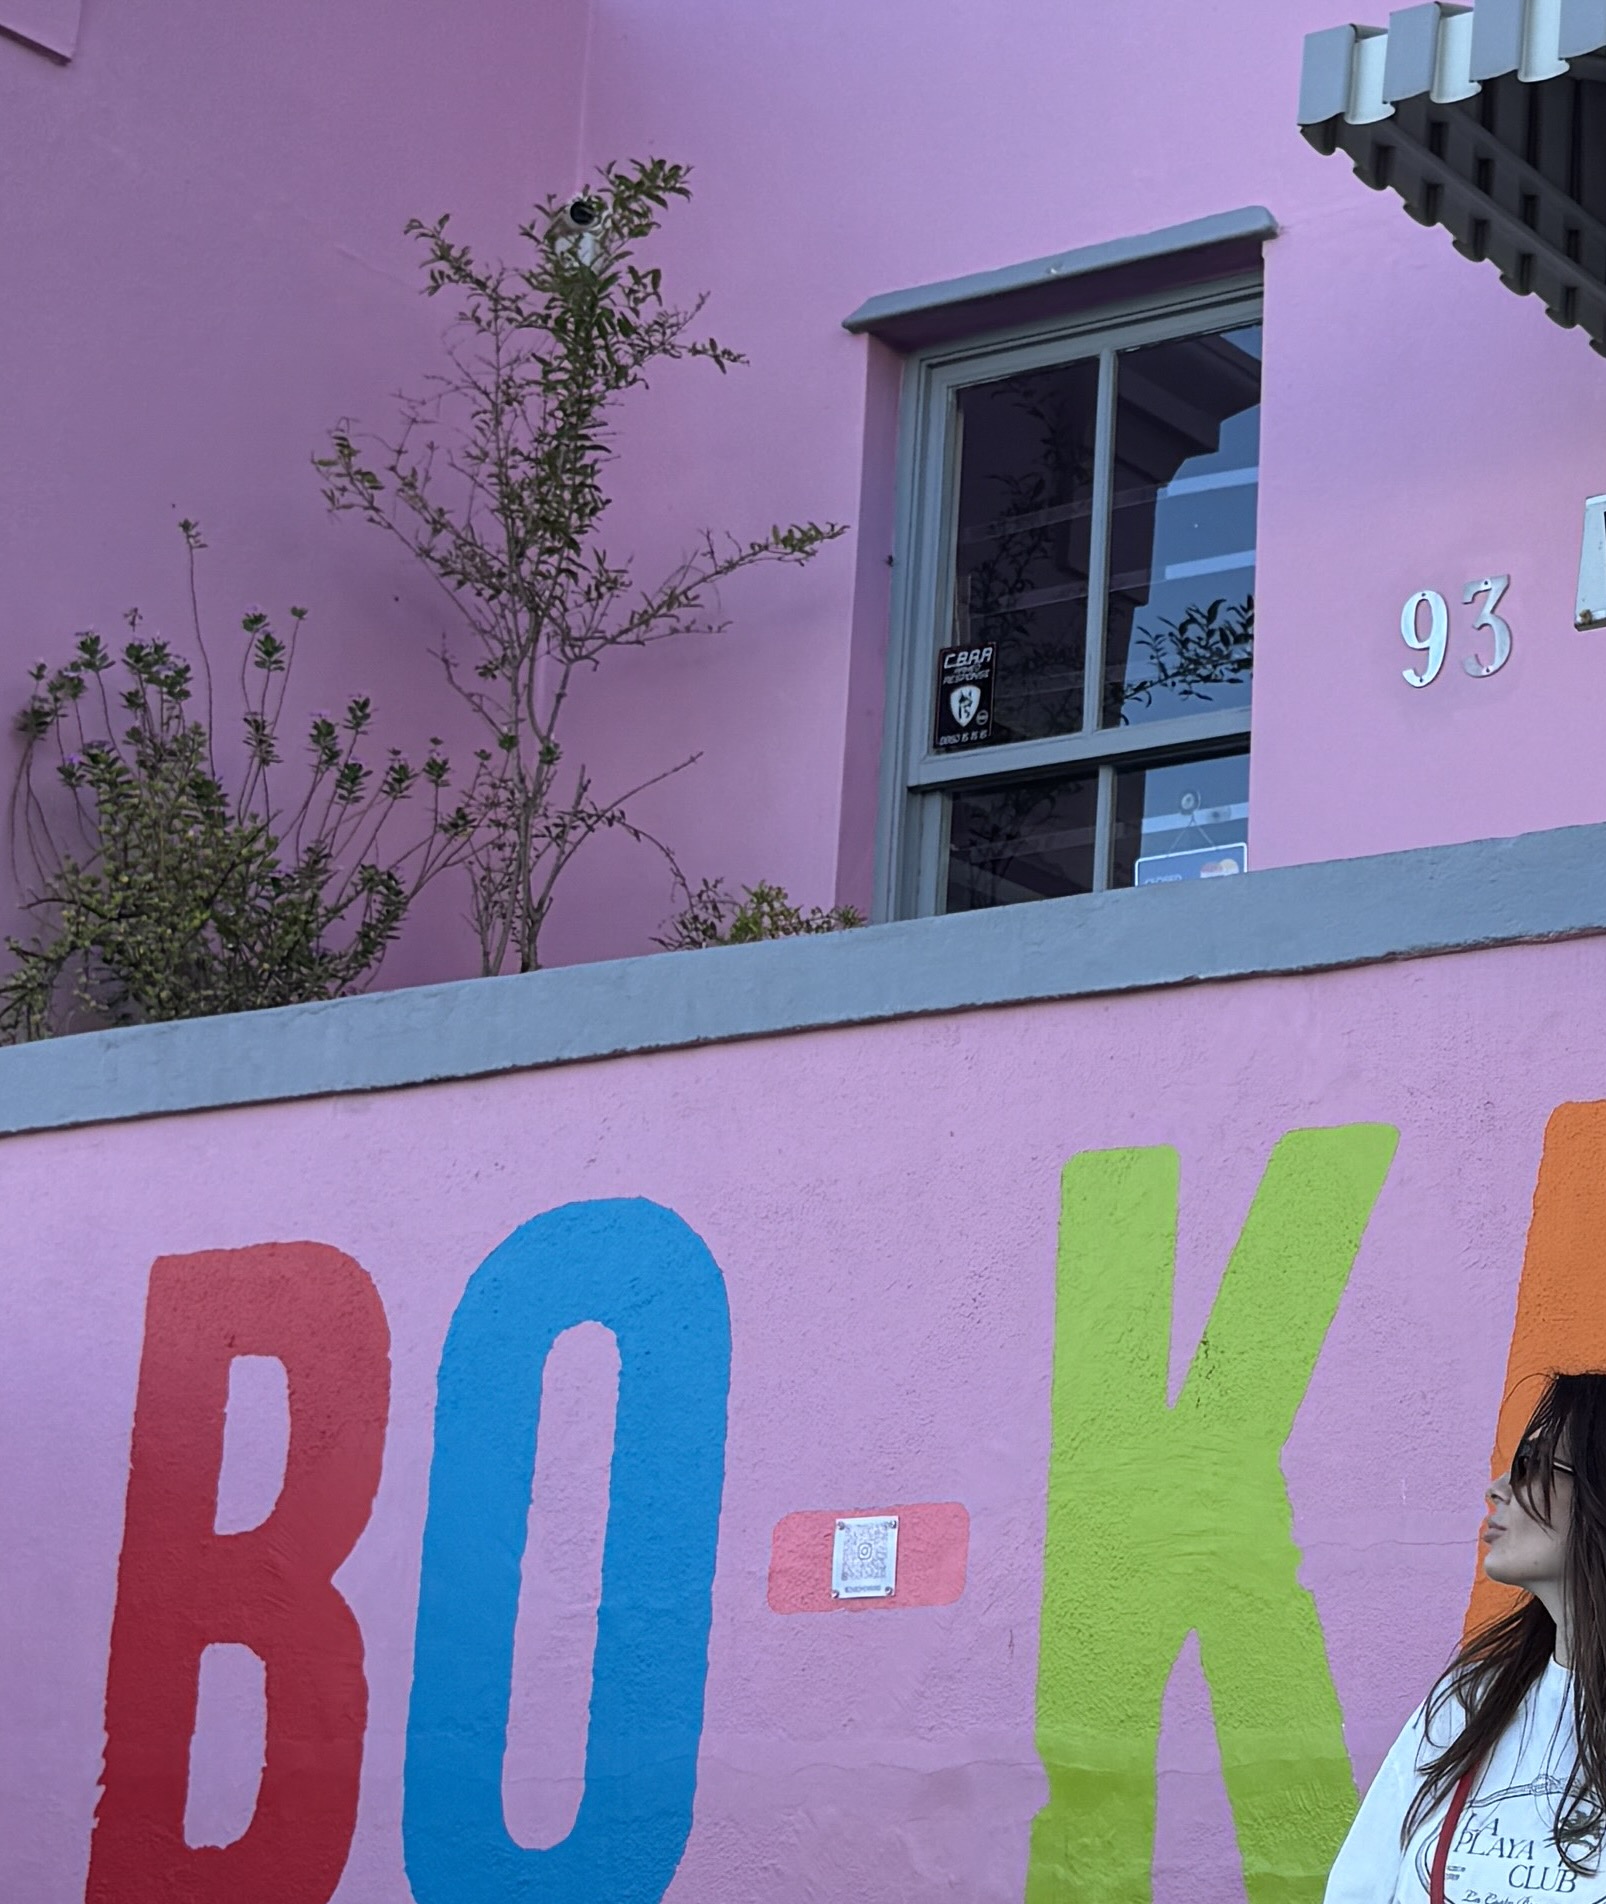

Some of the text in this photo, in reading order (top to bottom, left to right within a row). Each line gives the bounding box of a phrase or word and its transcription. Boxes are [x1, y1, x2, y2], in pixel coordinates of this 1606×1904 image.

[1400, 574, 1512, 689] 93
[1463, 1812, 1500, 1836] LA
[1453, 1830, 1535, 1860] PLAYA
[1508, 1864, 1578, 1893] CLUB
